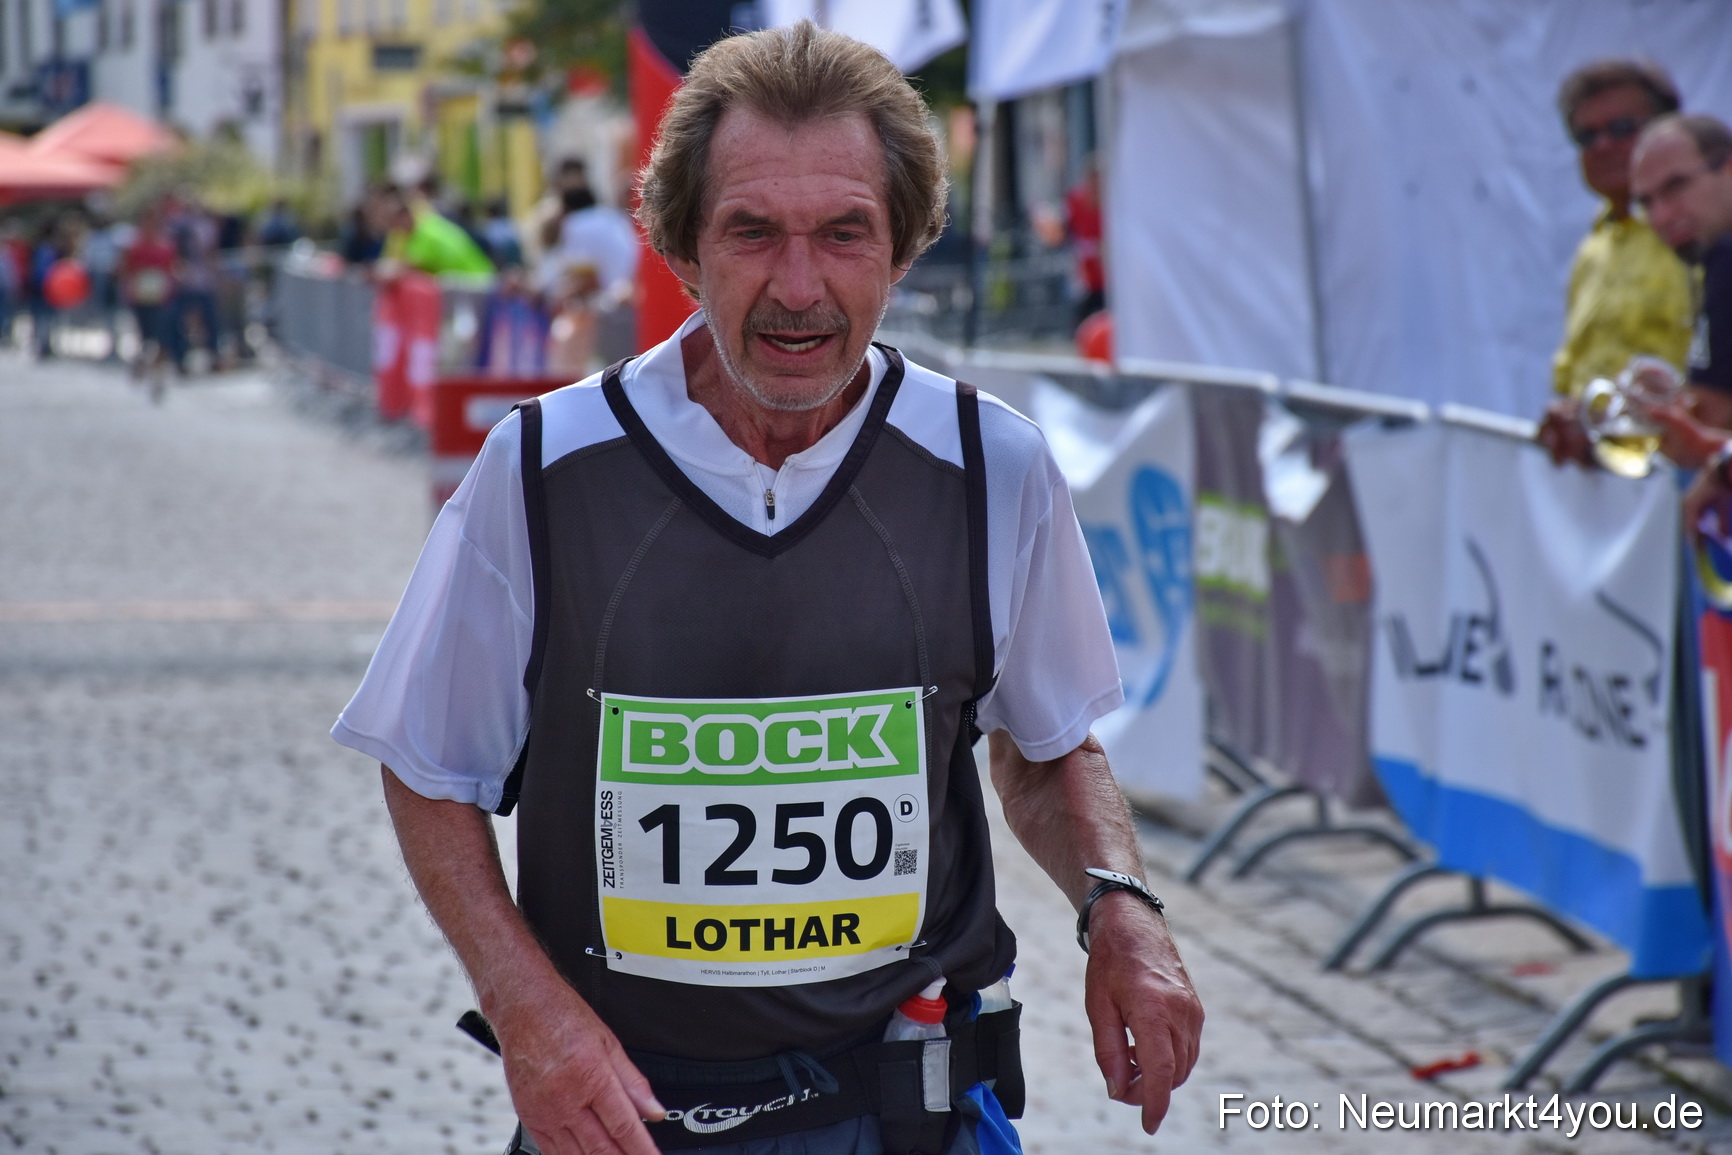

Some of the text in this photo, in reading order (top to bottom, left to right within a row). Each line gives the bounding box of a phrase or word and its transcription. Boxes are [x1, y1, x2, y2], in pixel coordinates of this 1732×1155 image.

[623, 706, 898, 773] BOCK
[900, 801, 913, 816] D
[638, 797, 893, 886] 1250
[666, 912, 861, 952] LOTHAR
[790, 966, 812, 974] Startblock
